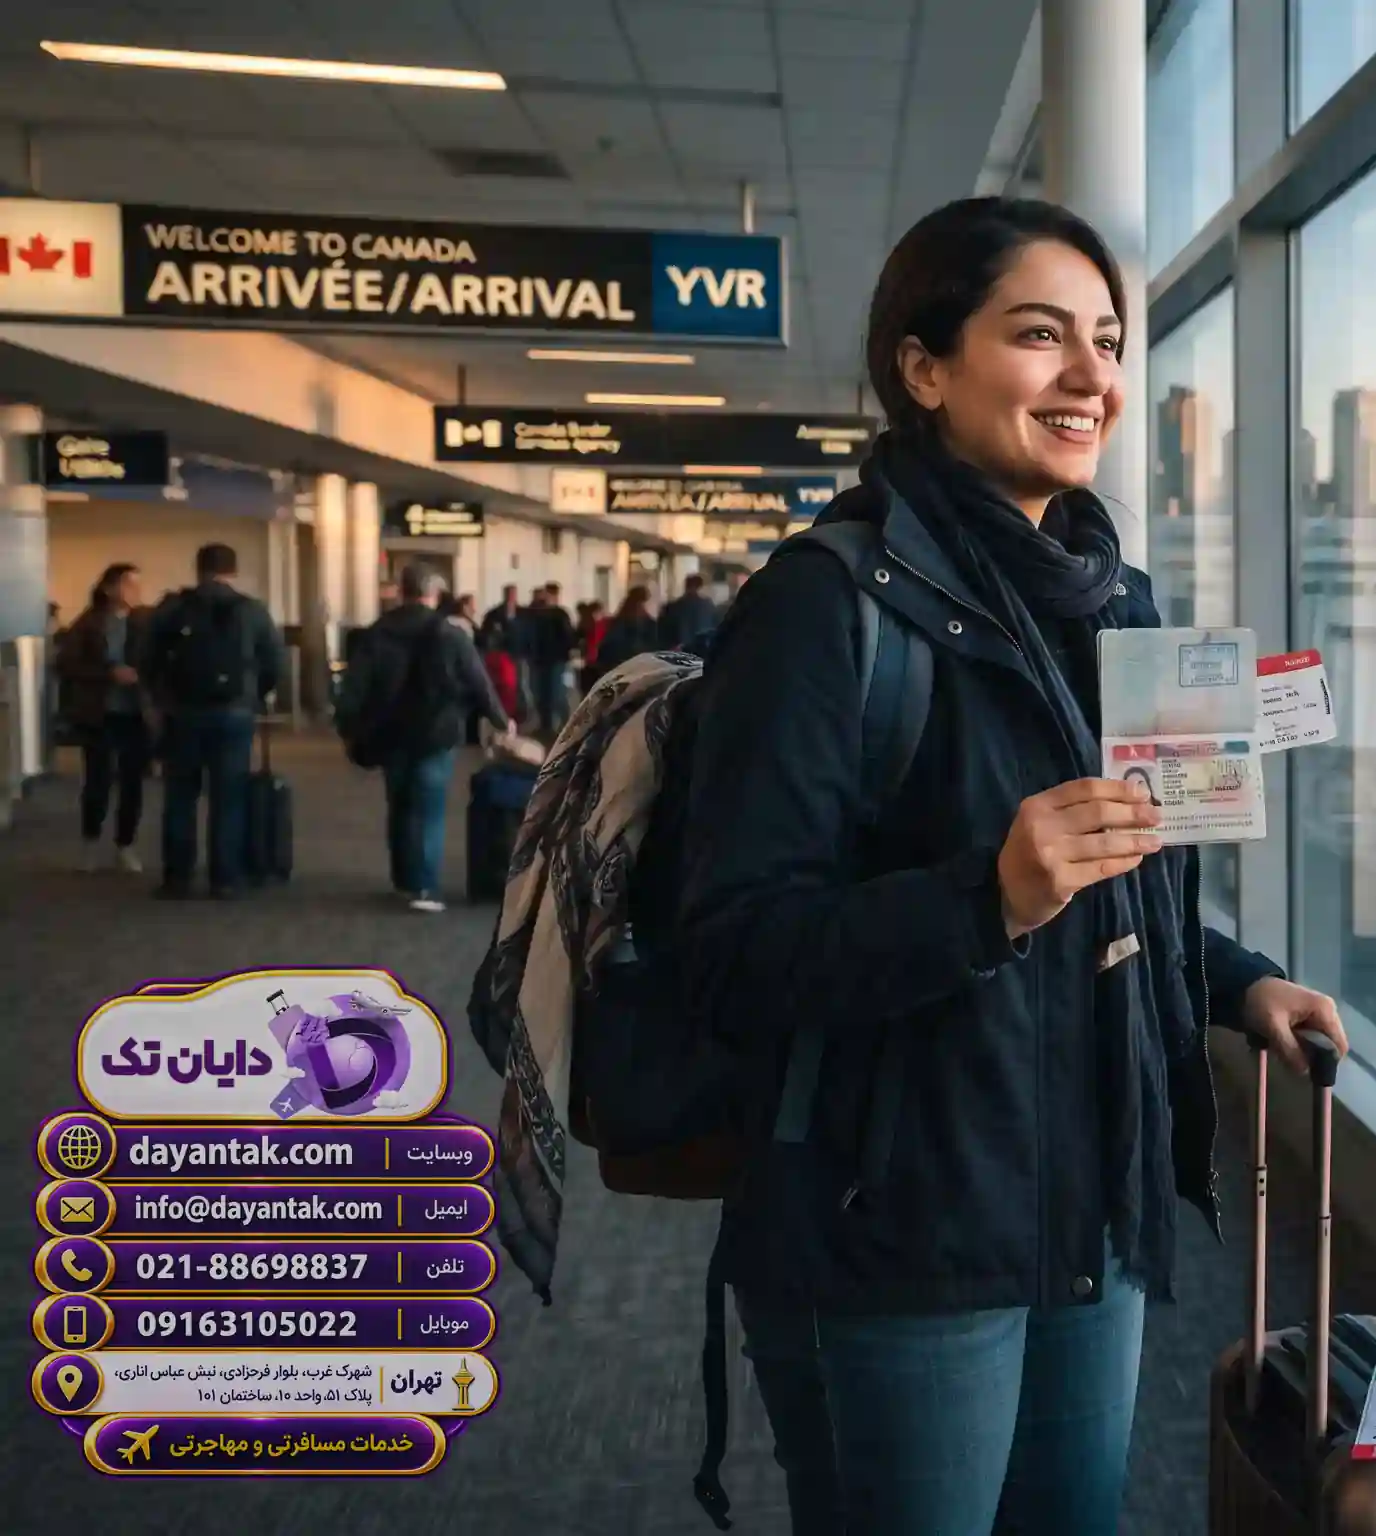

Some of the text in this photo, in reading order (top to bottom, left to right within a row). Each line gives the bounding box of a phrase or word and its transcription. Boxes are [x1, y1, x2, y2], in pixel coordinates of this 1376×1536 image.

[145, 224, 477, 264] WELCOME TO CANADA
[147, 260, 636, 321] ARRIVÉE/ARRIVAL
[665, 265, 768, 310] YVR
